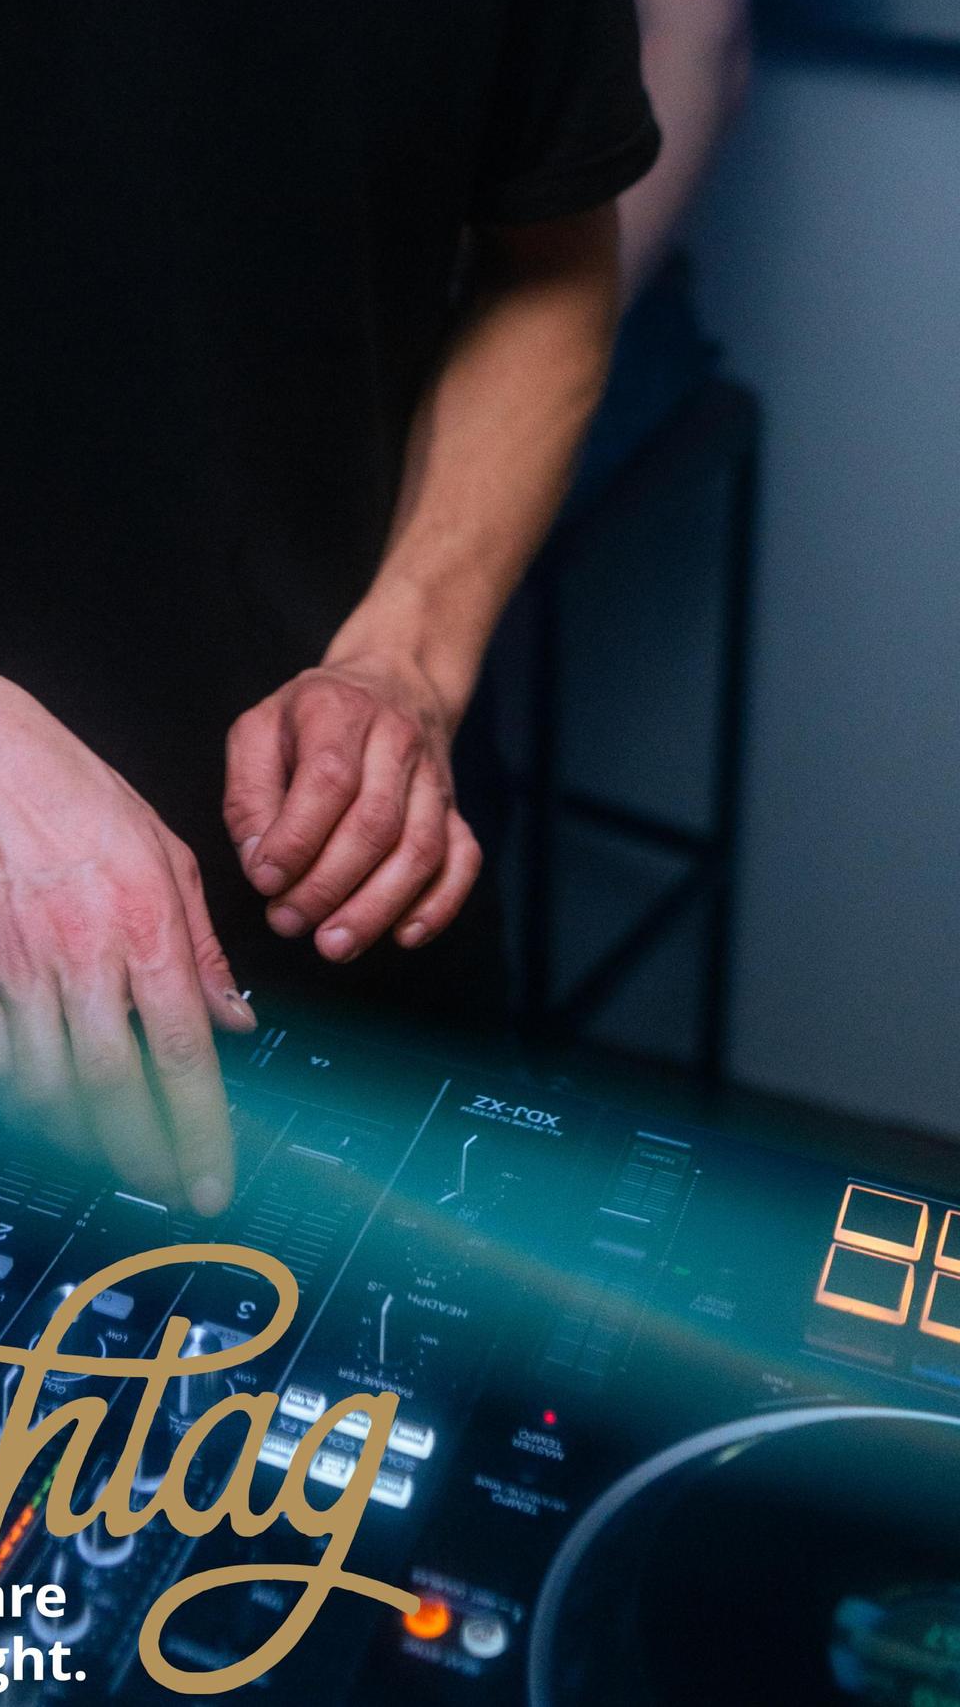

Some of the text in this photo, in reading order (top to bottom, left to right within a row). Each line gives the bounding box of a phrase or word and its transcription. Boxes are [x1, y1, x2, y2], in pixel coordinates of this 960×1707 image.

[472, 1095, 560, 1127] XDJ-XZ
[236, 1300, 257, 1321] 3
[104, 1329, 129, 1344] LOW
[232, 1371, 258, 1386] LOW
[337, 1368, 415, 1399] PARAMETER
[511, 1435, 565, 1462] MASTER
[518, 1427, 561, 1453] TEMPO
[491, 1492, 540, 1516] TEMPO
